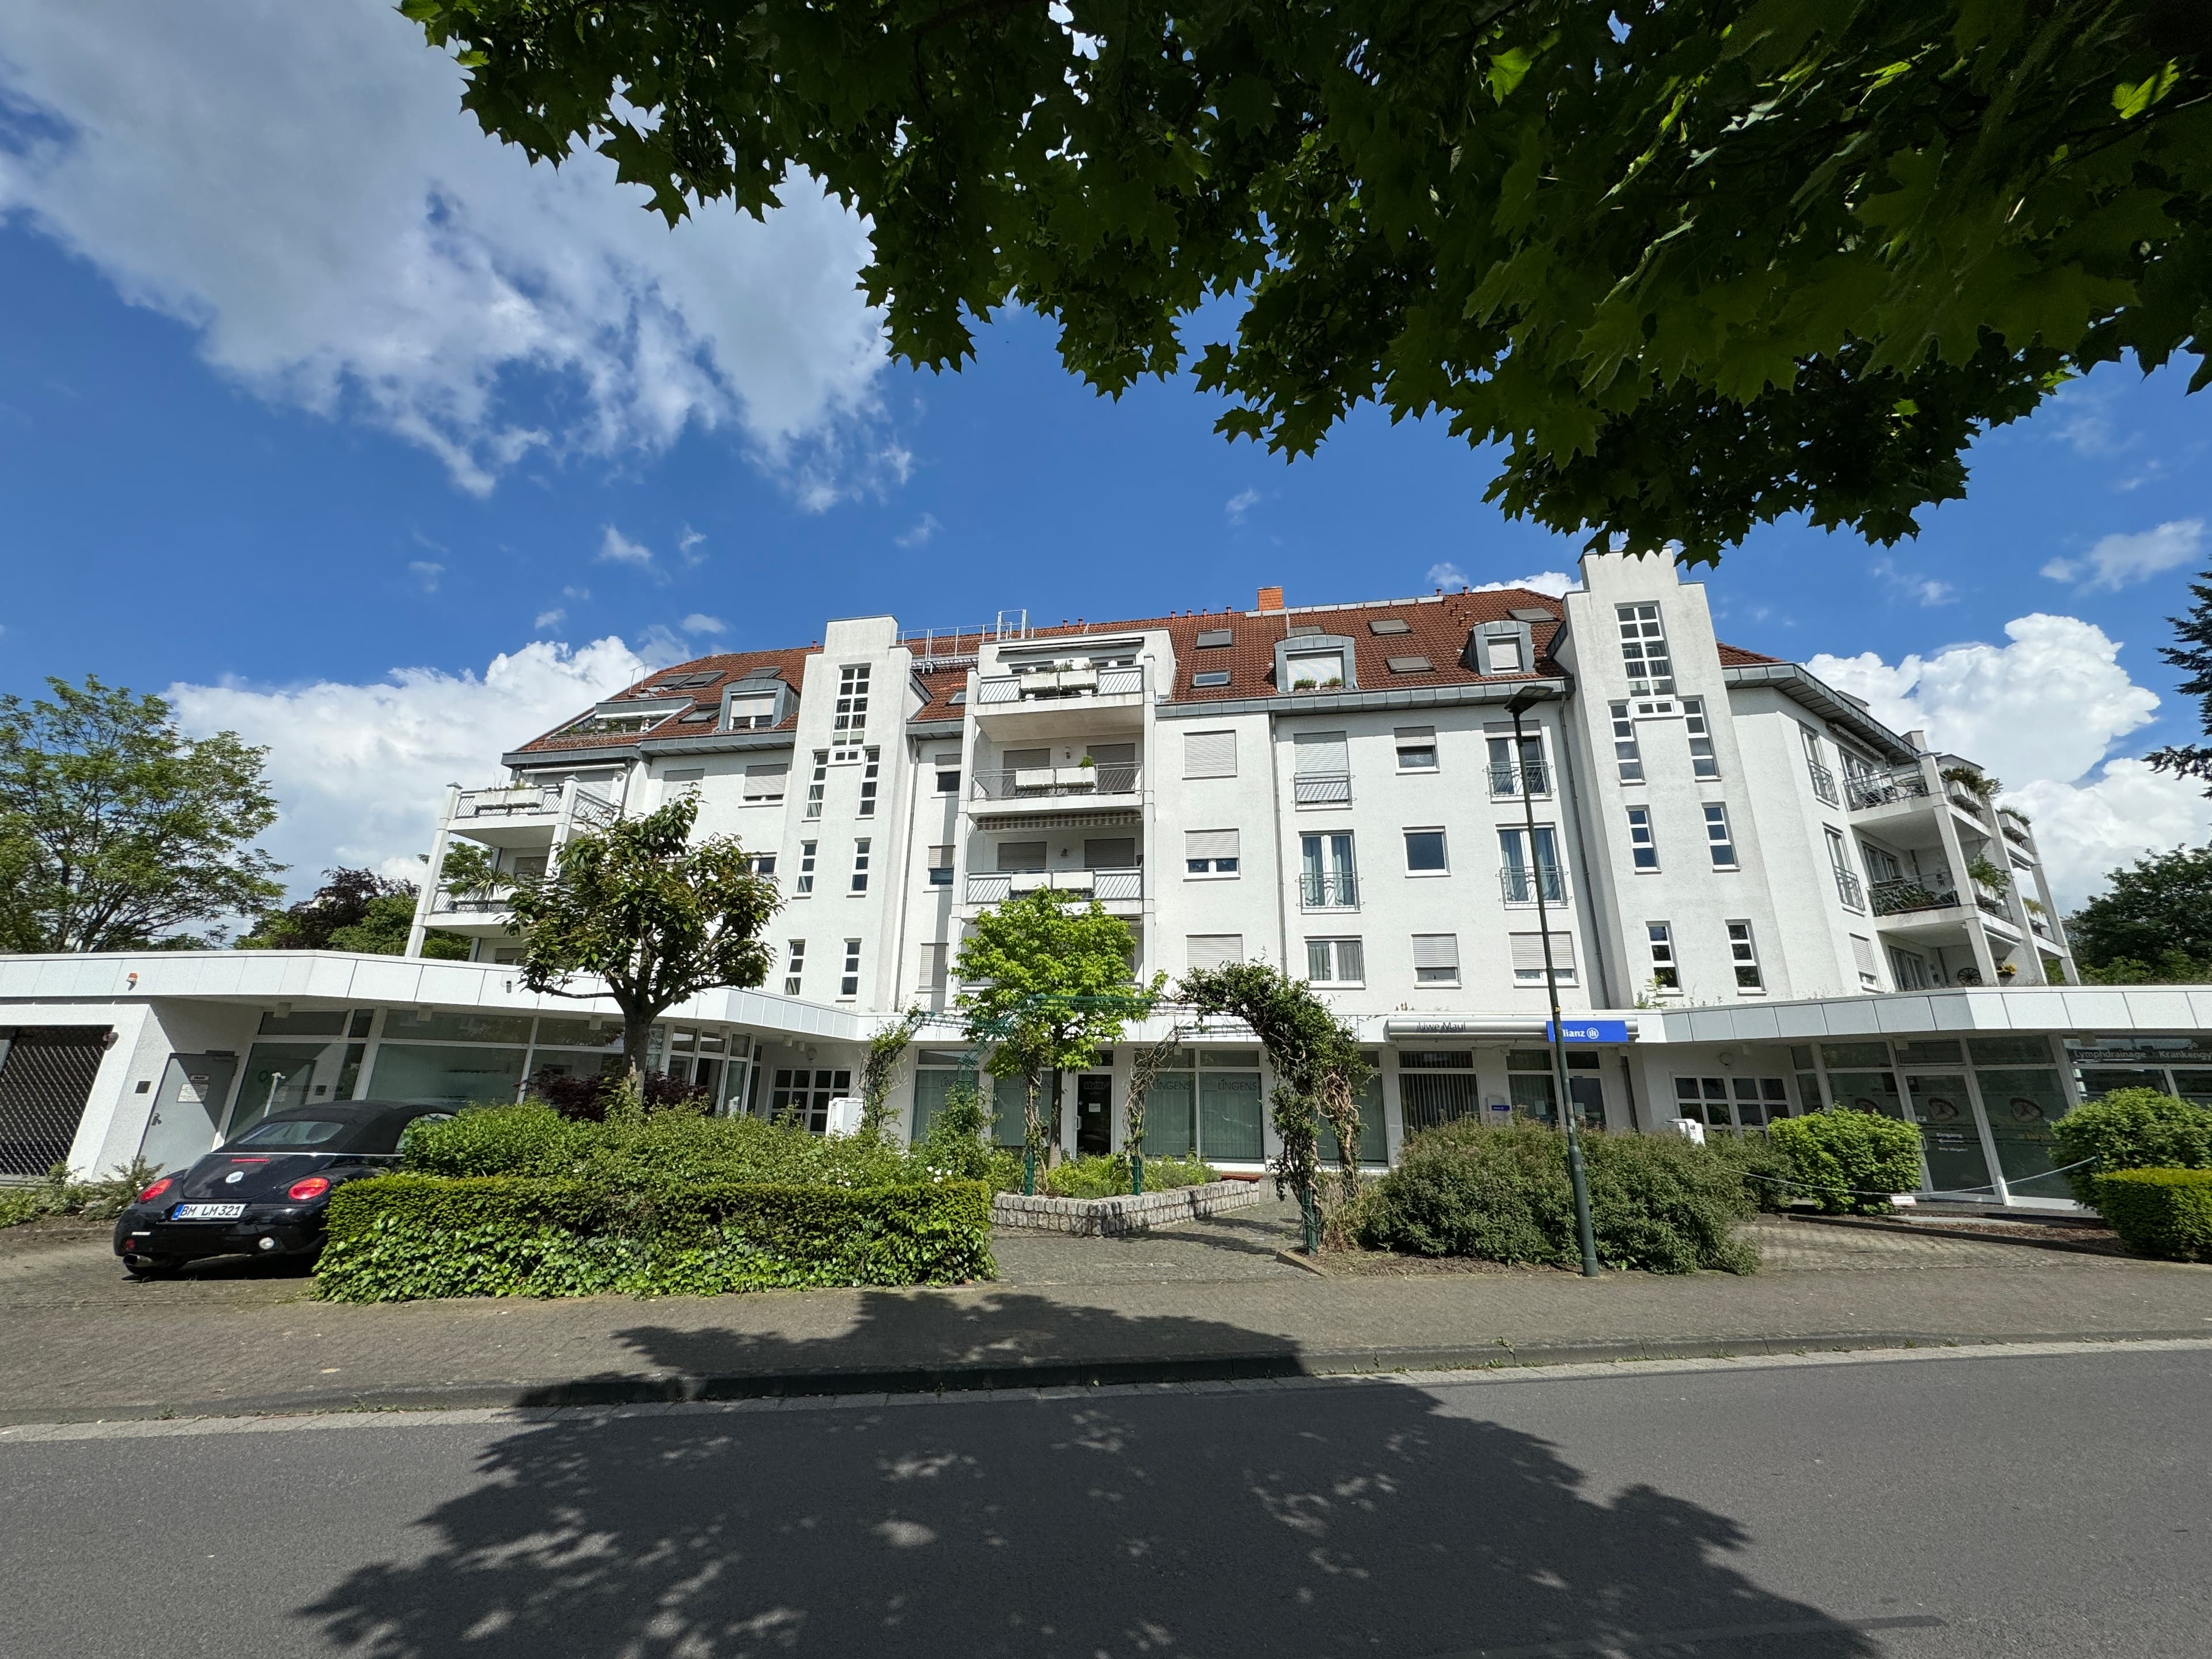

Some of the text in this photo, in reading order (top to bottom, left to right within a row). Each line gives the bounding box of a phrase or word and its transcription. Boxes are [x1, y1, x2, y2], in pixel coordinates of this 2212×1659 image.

[1418, 1021, 1440, 1031] Uwe
[1562, 1028, 1586, 1037] lianz
[2074, 1050, 2147, 1060] Lymphdrainage
[180, 1206, 198, 1216] BM
